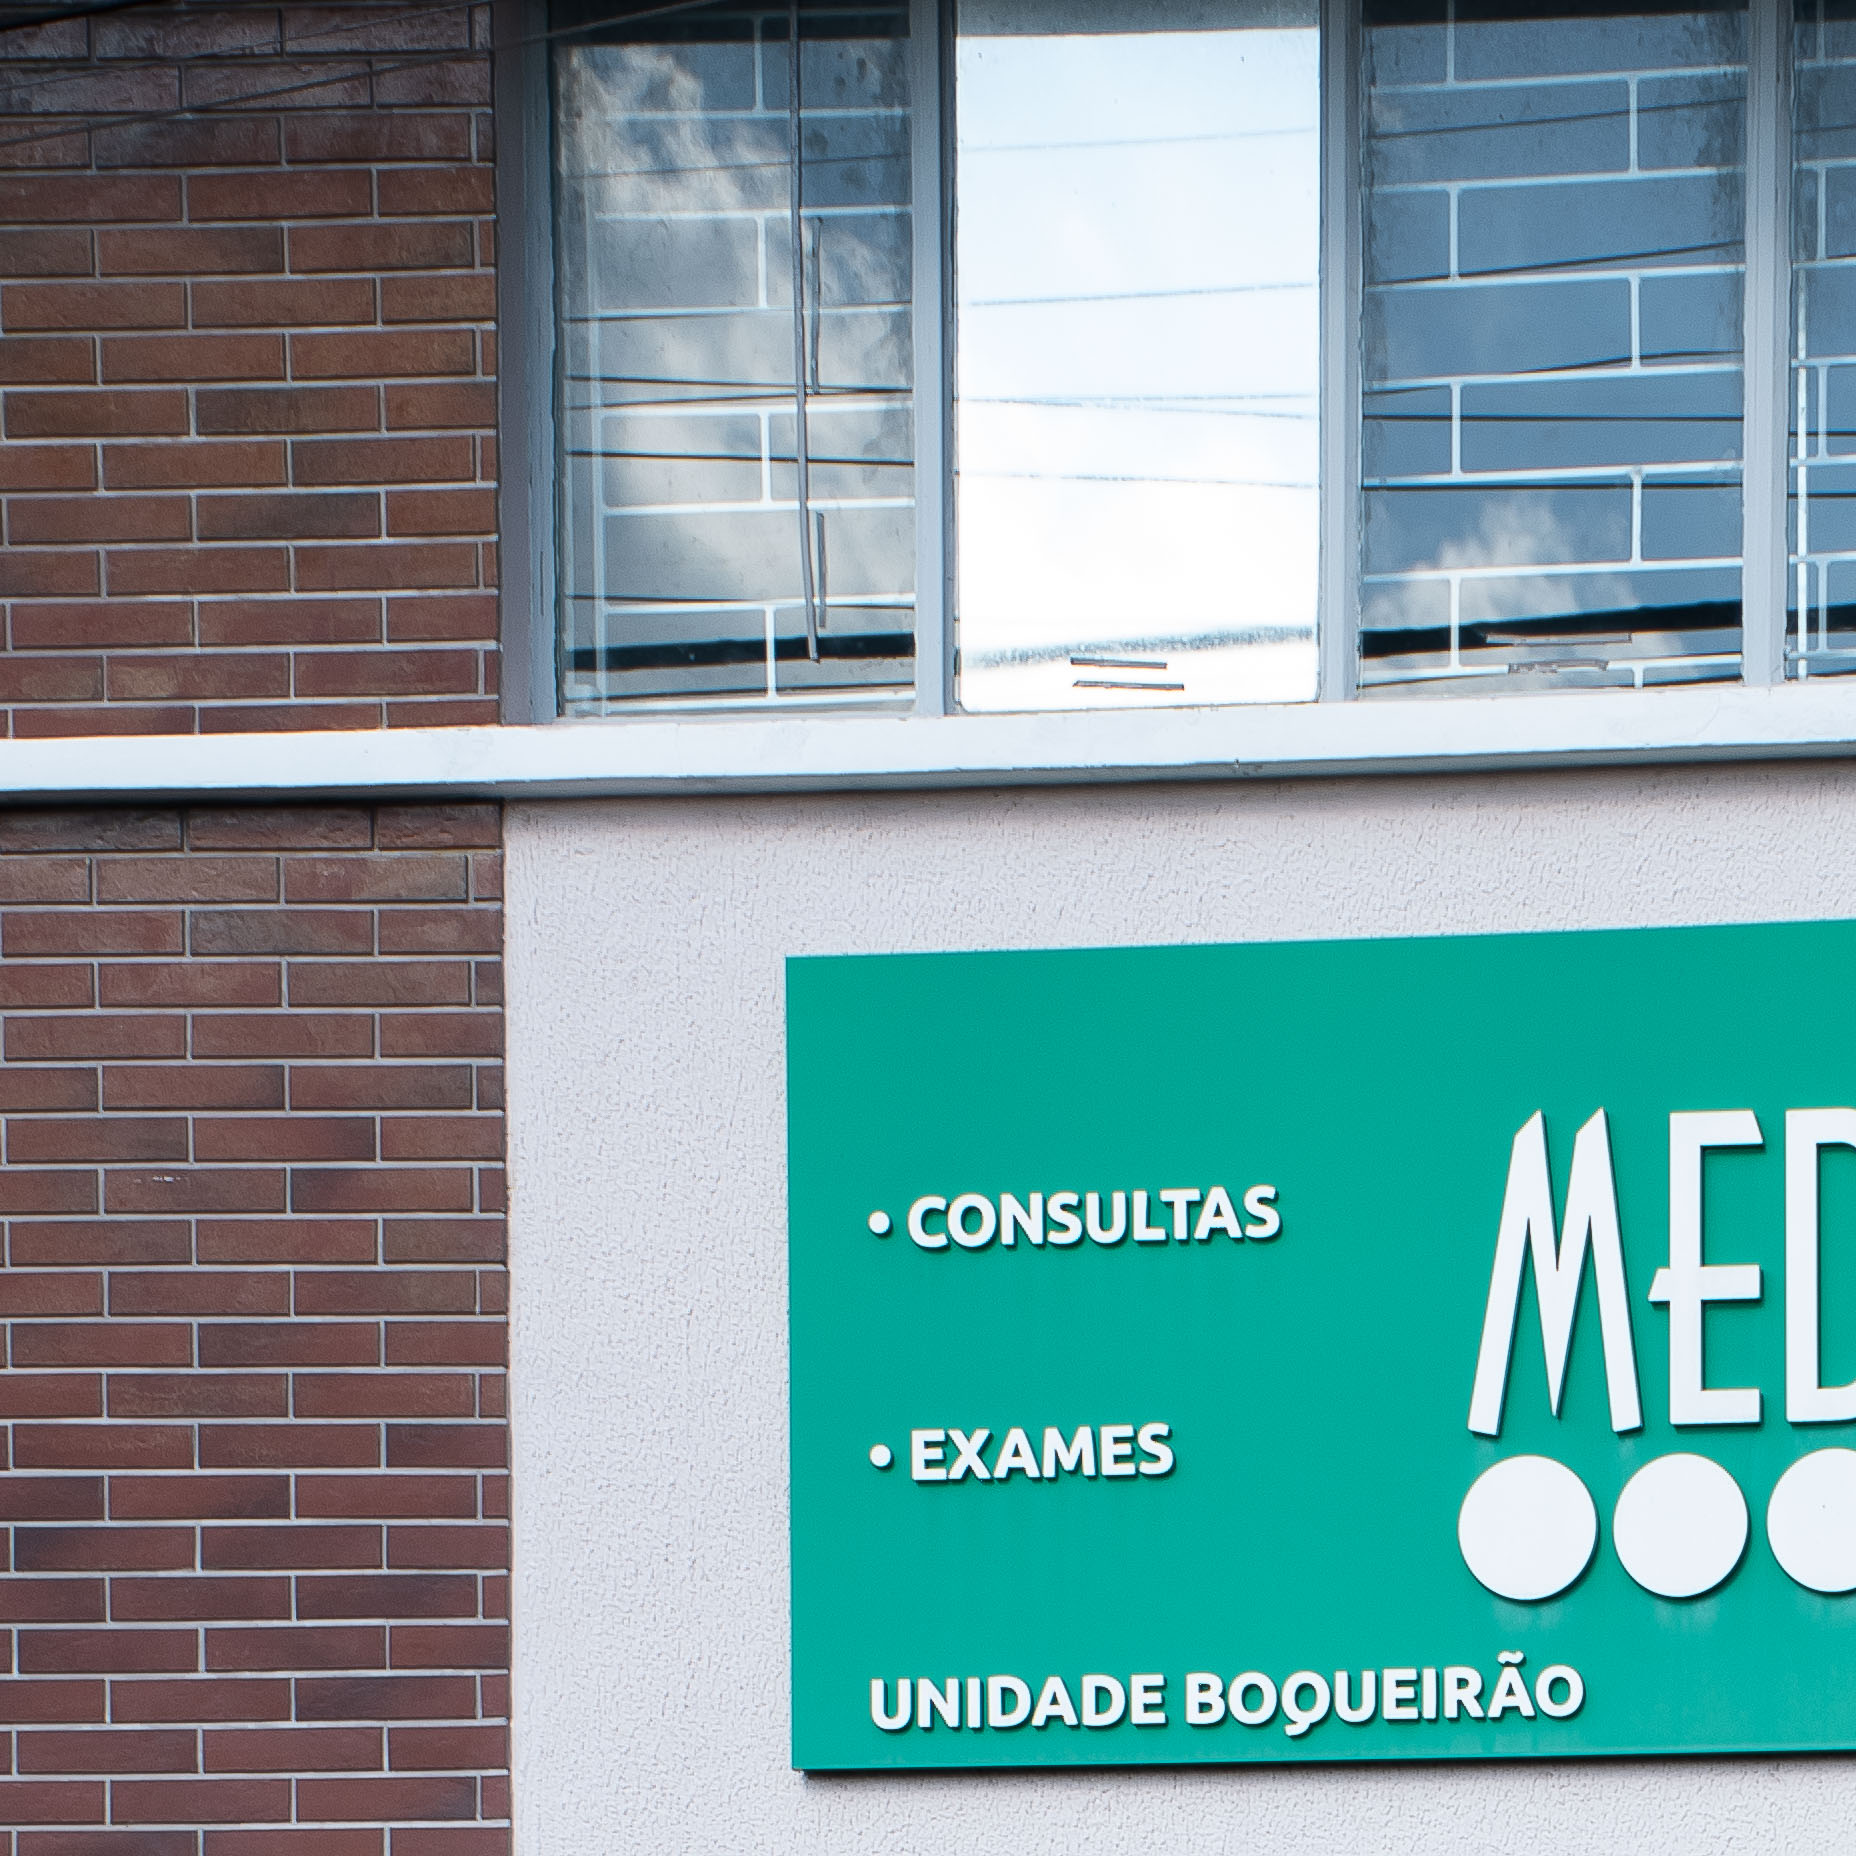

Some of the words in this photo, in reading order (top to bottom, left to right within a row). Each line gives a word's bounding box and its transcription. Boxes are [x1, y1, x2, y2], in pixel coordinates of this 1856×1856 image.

[907, 1185, 1281, 1250] CONSULTAS
[911, 1423, 1175, 1483] EXAMES
[870, 1672, 1168, 1733] UNIDADE
[1186, 1651, 1587, 1737] BOQUEIRÃO
